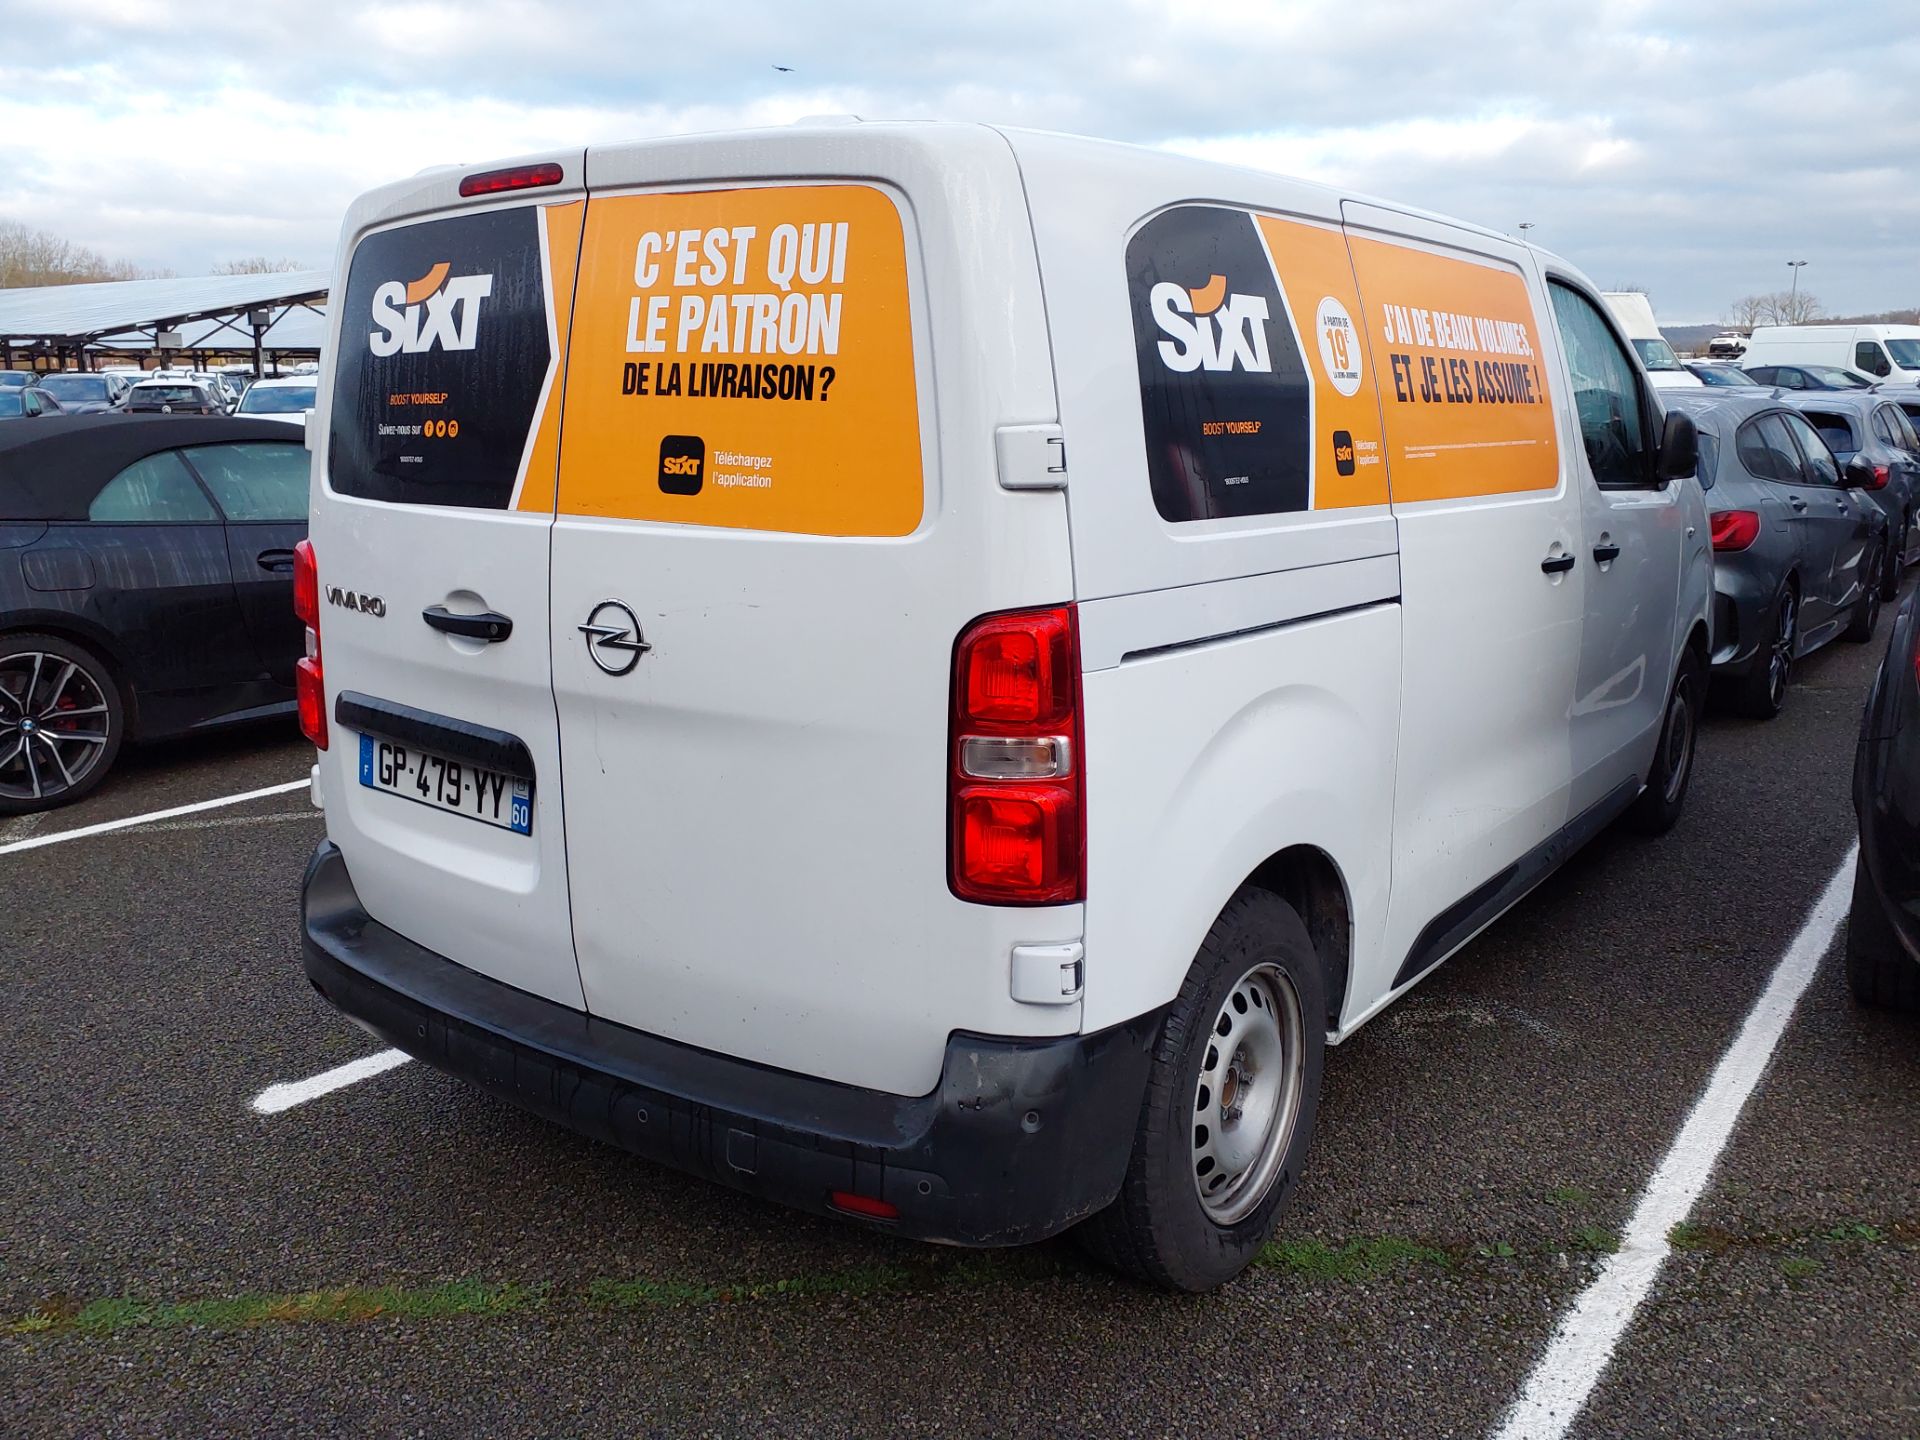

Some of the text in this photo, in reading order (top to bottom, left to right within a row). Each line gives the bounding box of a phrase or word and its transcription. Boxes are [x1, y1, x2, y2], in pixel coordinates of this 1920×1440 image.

[634, 222, 849, 291] C'EST QUI
[625, 293, 842, 355] LE PATRON
[1383, 303, 1535, 360] J'AI DE BEAUX VOLUMES,
[622, 363, 649, 396] DE
[655, 363, 682, 396] LA
[1390, 354, 1415, 402] ET
[1420, 355, 1442, 403] JE
[1441, 358, 1473, 404] LES
[389, 394, 410, 406] BOOST
[378, 423, 422, 435] Suivez-nous sur
[1203, 422, 1225, 435] BOOST
[714, 451, 773, 470] Téléchargez
[712, 472, 772, 488] l'application
[326, 584, 386, 617] VIVARO
[364, 764, 369, 776] F
[512, 803, 529, 827] 60
